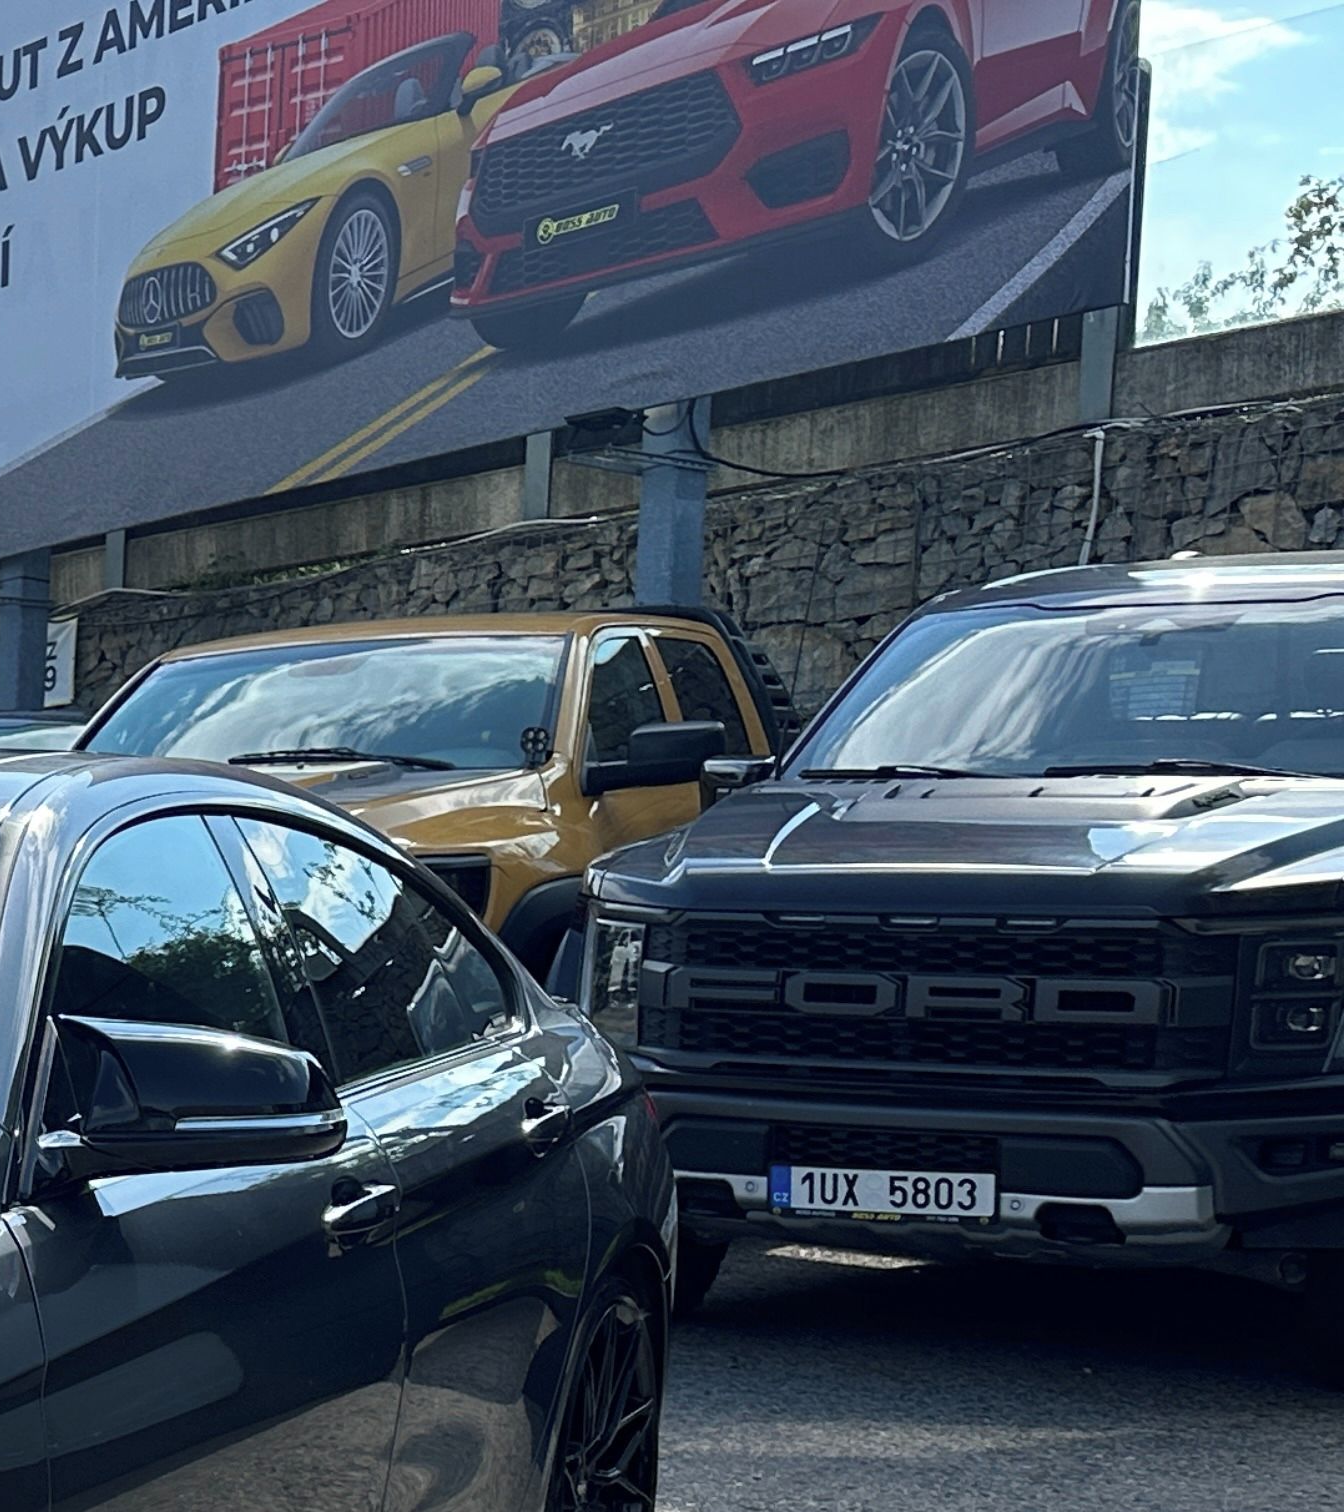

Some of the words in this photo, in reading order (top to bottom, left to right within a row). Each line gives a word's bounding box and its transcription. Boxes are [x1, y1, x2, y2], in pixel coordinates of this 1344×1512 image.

[57, 21, 85, 80] Z
[18, 85, 166, 182] VÝKUP
[667, 967, 1162, 1024] FORD
[773, 1192, 789, 1203] CZ
[800, 1171, 859, 1207] 1UX
[888, 1175, 977, 1211] 5803
